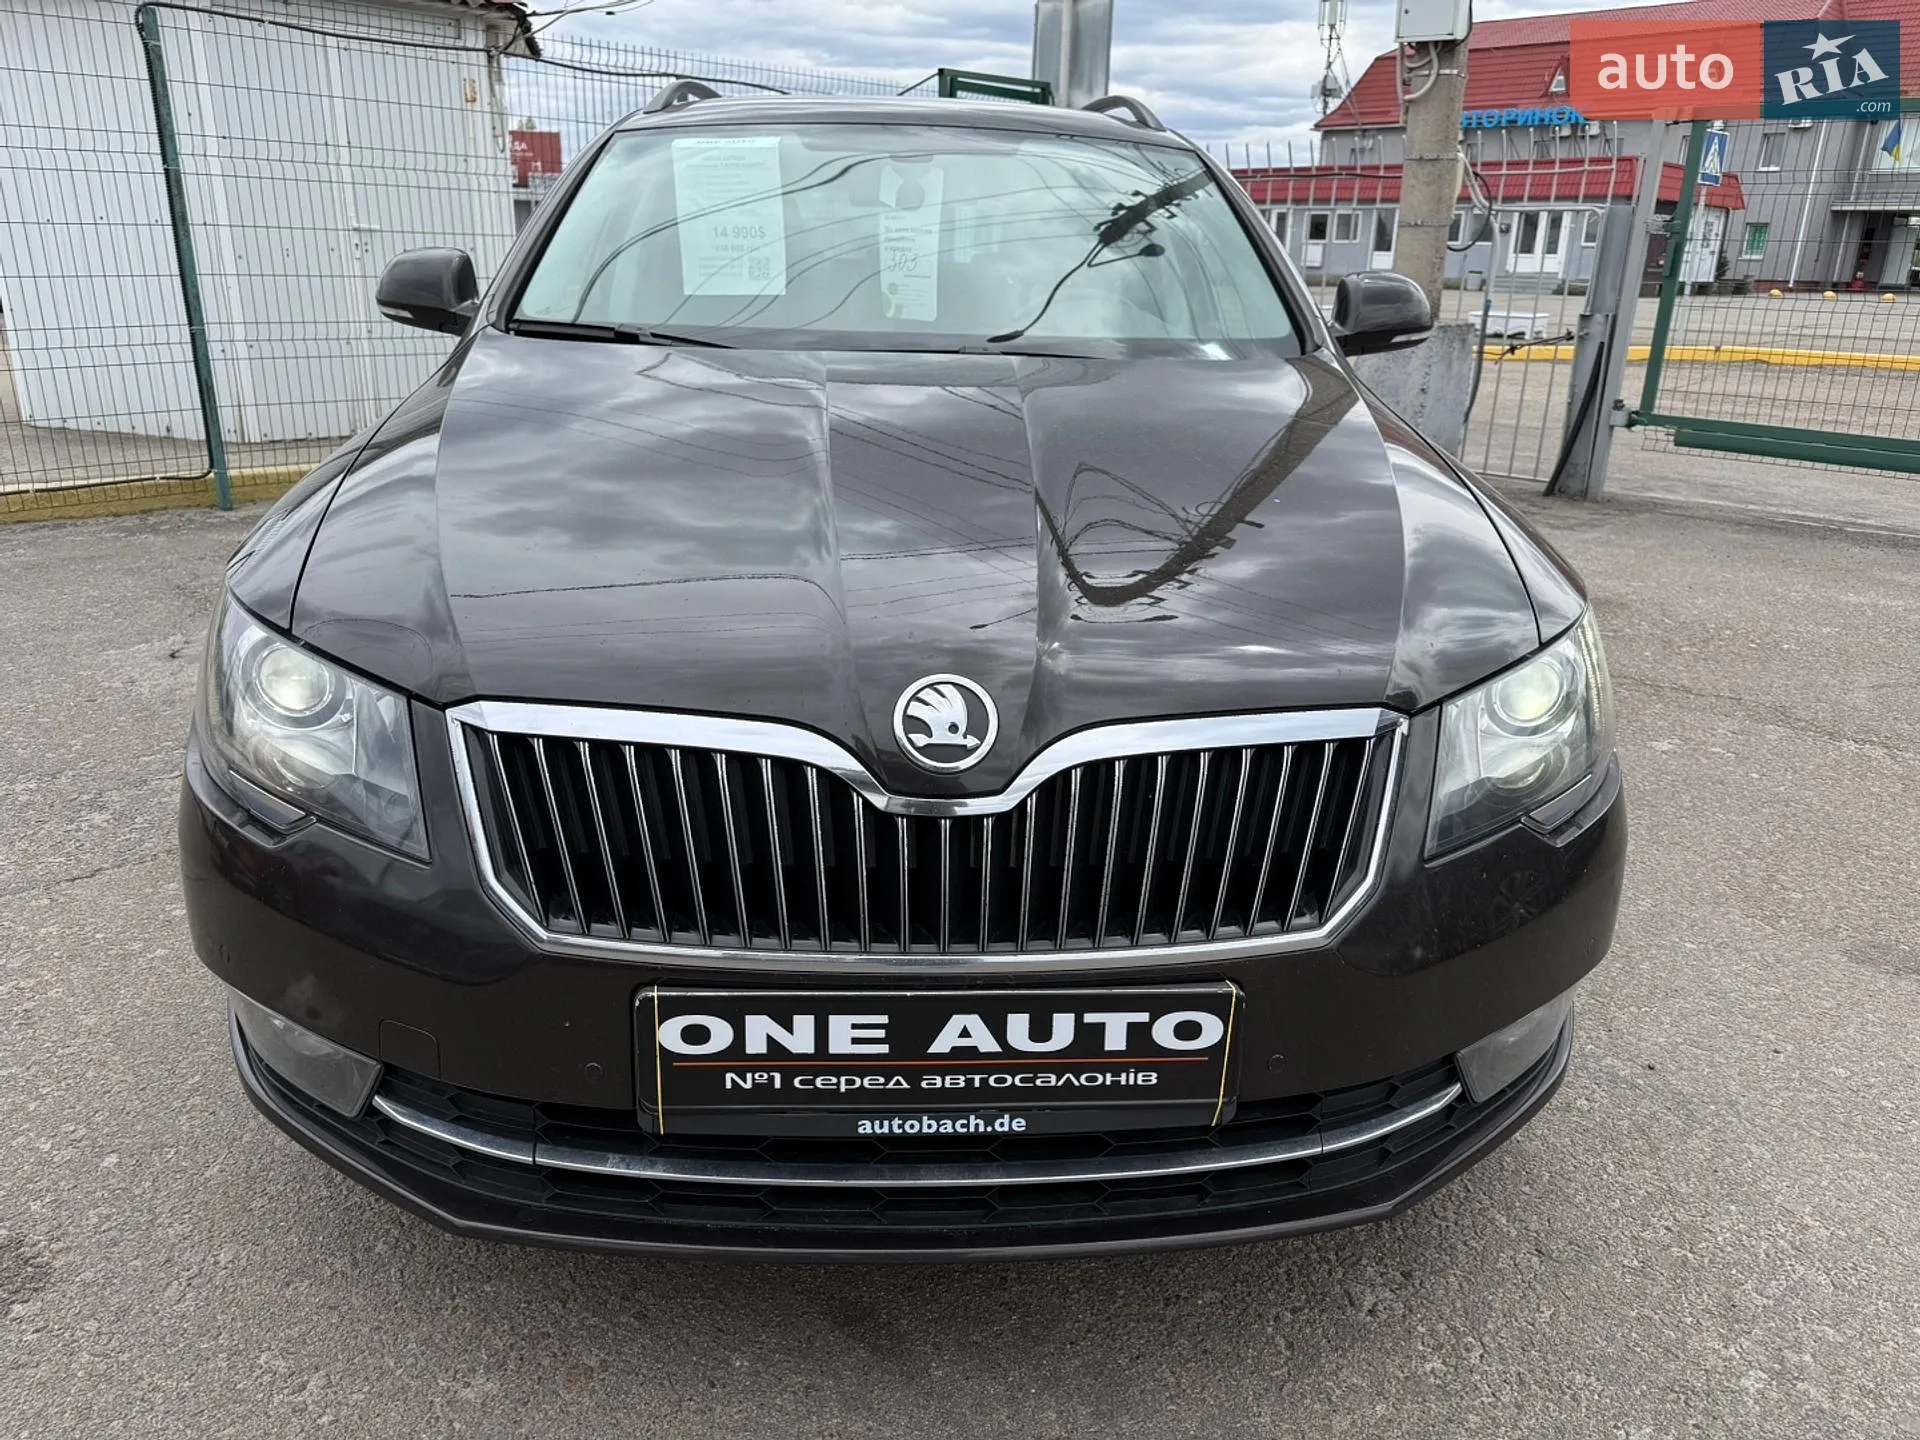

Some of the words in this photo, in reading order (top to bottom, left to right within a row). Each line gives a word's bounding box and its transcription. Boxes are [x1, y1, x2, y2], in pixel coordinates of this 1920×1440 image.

[712, 225, 728, 239] 14
[658, 1014, 890, 1055] ONE
[926, 1010, 1224, 1054] AUTO
[793, 1075, 911, 1093] серед
[920, 1069, 1159, 1089] автосалонів
[857, 1114, 1027, 1135] autobach.de
